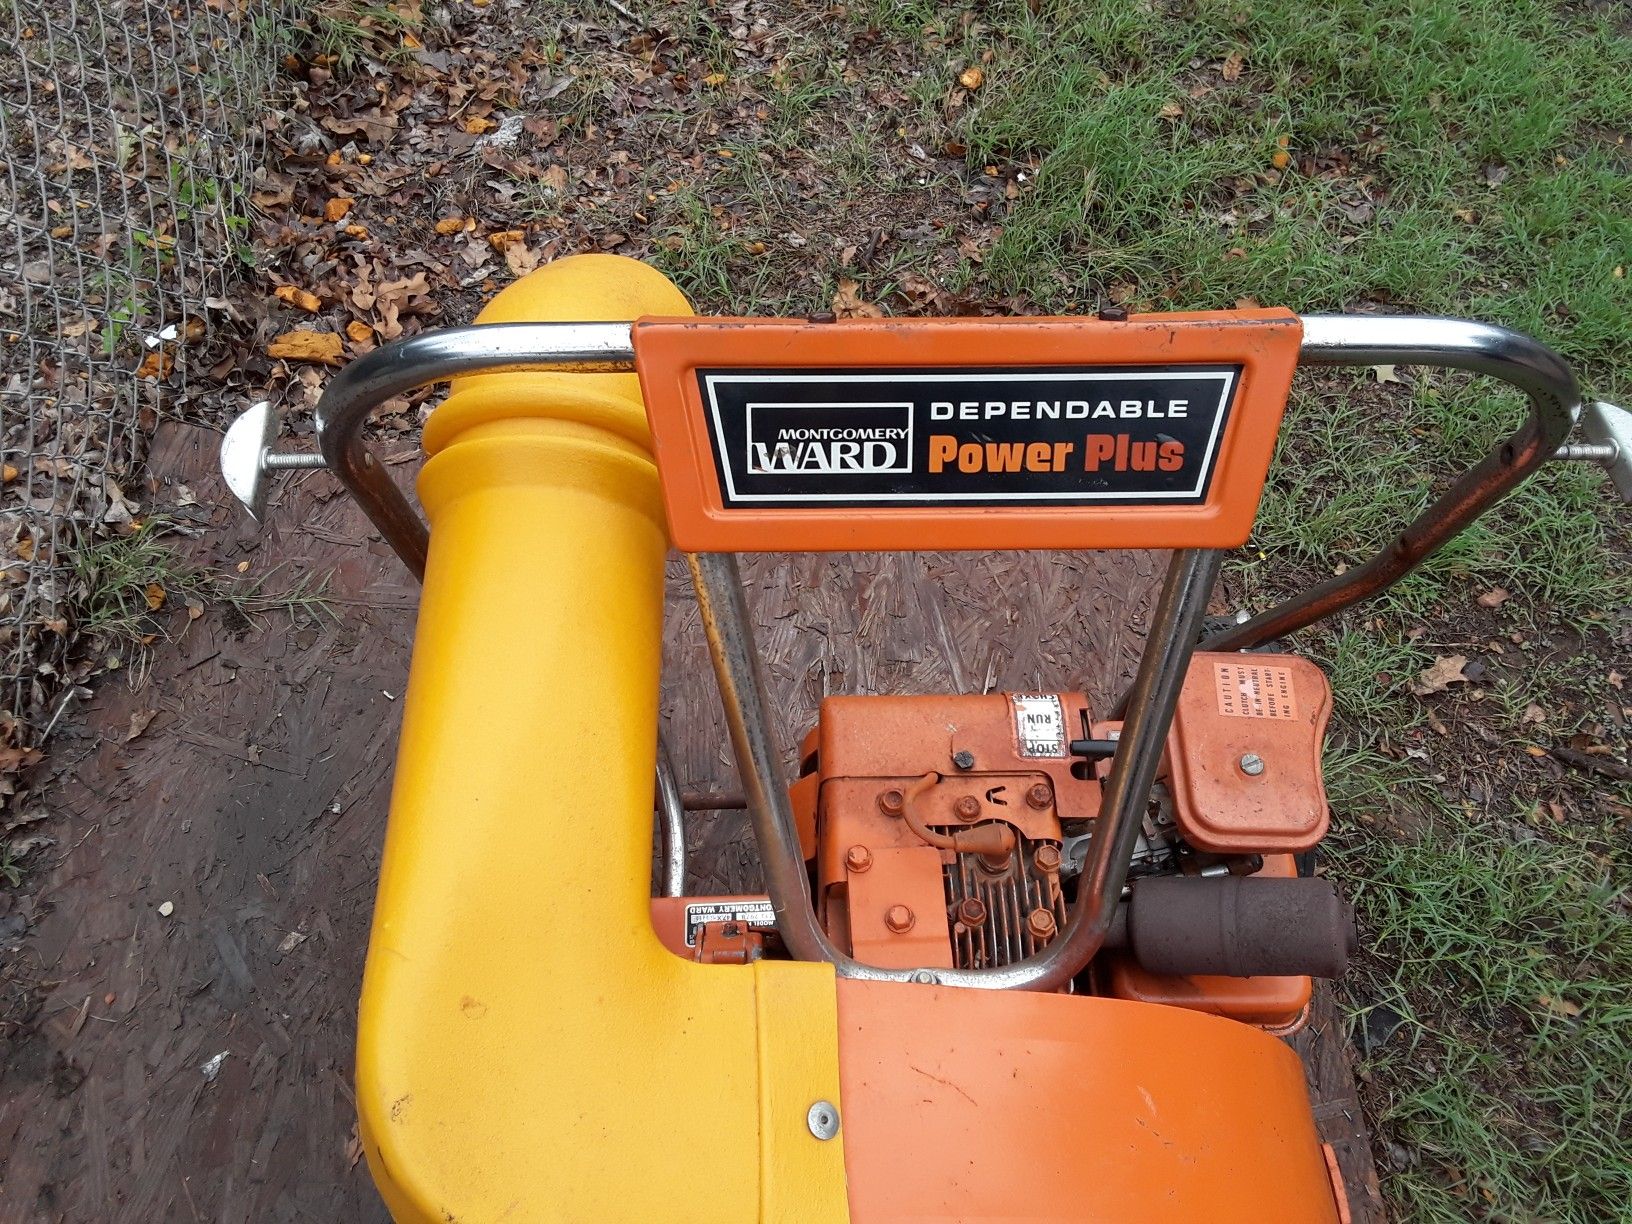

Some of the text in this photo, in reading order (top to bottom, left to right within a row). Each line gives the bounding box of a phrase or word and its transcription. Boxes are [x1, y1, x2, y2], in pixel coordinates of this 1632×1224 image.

[930, 399, 1190, 421] DEPENDABLE
[777, 428, 909, 441] MONTGOMERY
[751, 441, 897, 472] WARD
[928, 433, 1185, 474] Power Plus
[1220, 667, 1234, 713] CAUTION
[1237, 667, 1250, 715] CLUTCH MUST
[1251, 668, 1261, 695] NEUTRAL
[1267, 693, 1277, 717] BEFORE
[1278, 672, 1291, 718] ING ENGINE
[1026, 713, 1051, 724] RUN
[1255, 708, 1264, 716] BE
[1027, 743, 1058, 754] STOP
[689, 904, 773, 914] ONTGOMERY WARD
